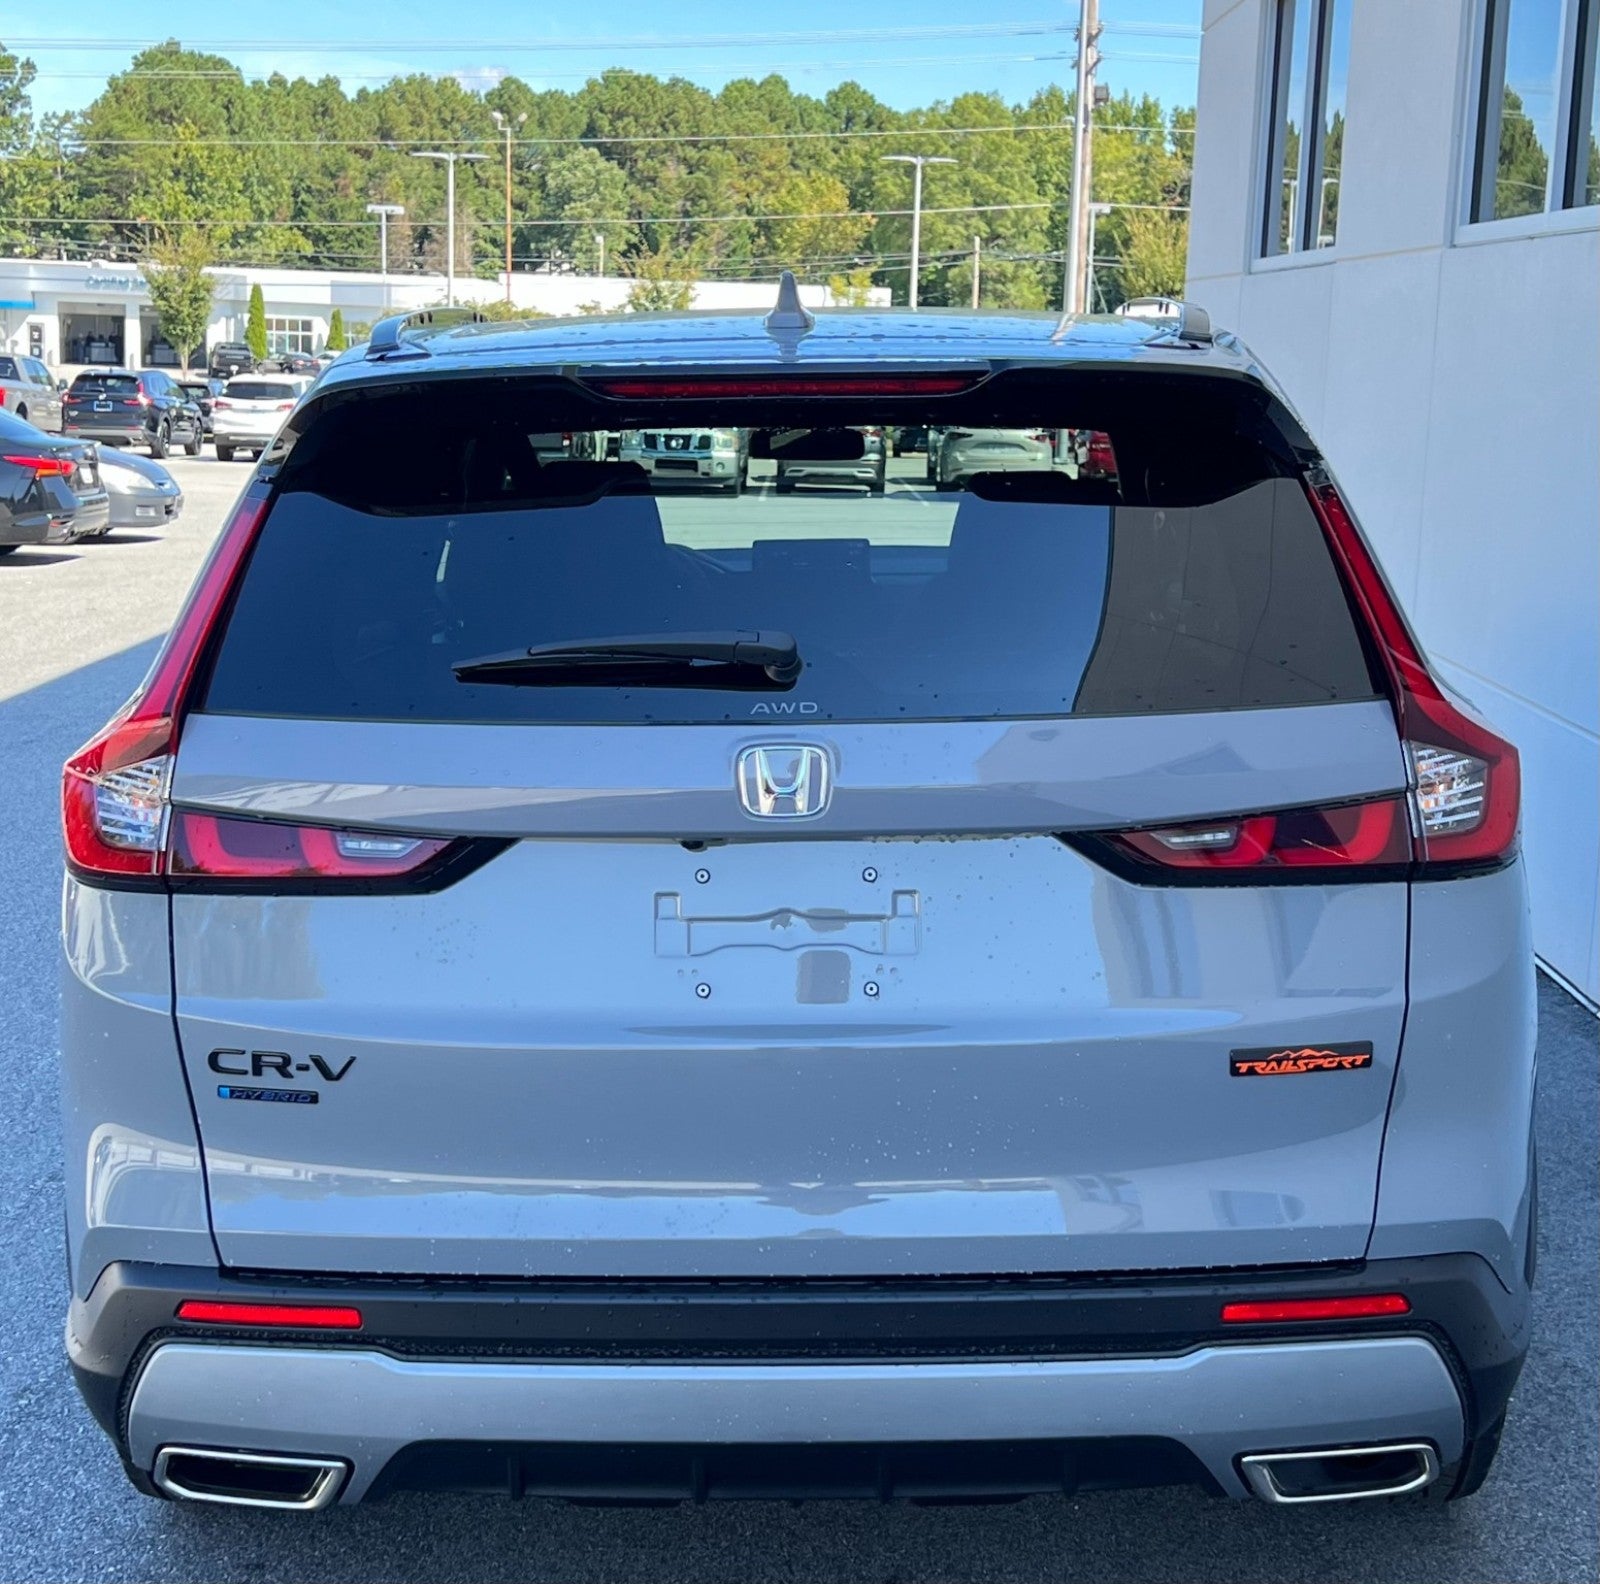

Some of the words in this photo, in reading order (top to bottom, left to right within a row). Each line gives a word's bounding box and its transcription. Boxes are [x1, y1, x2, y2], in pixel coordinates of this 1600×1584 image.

[750, 701, 818, 715] AWD
[207, 1048, 357, 1081] CR-V
[1235, 1054, 1370, 1074] TRAILSPORT
[231, 1088, 312, 1103] HYBRID
